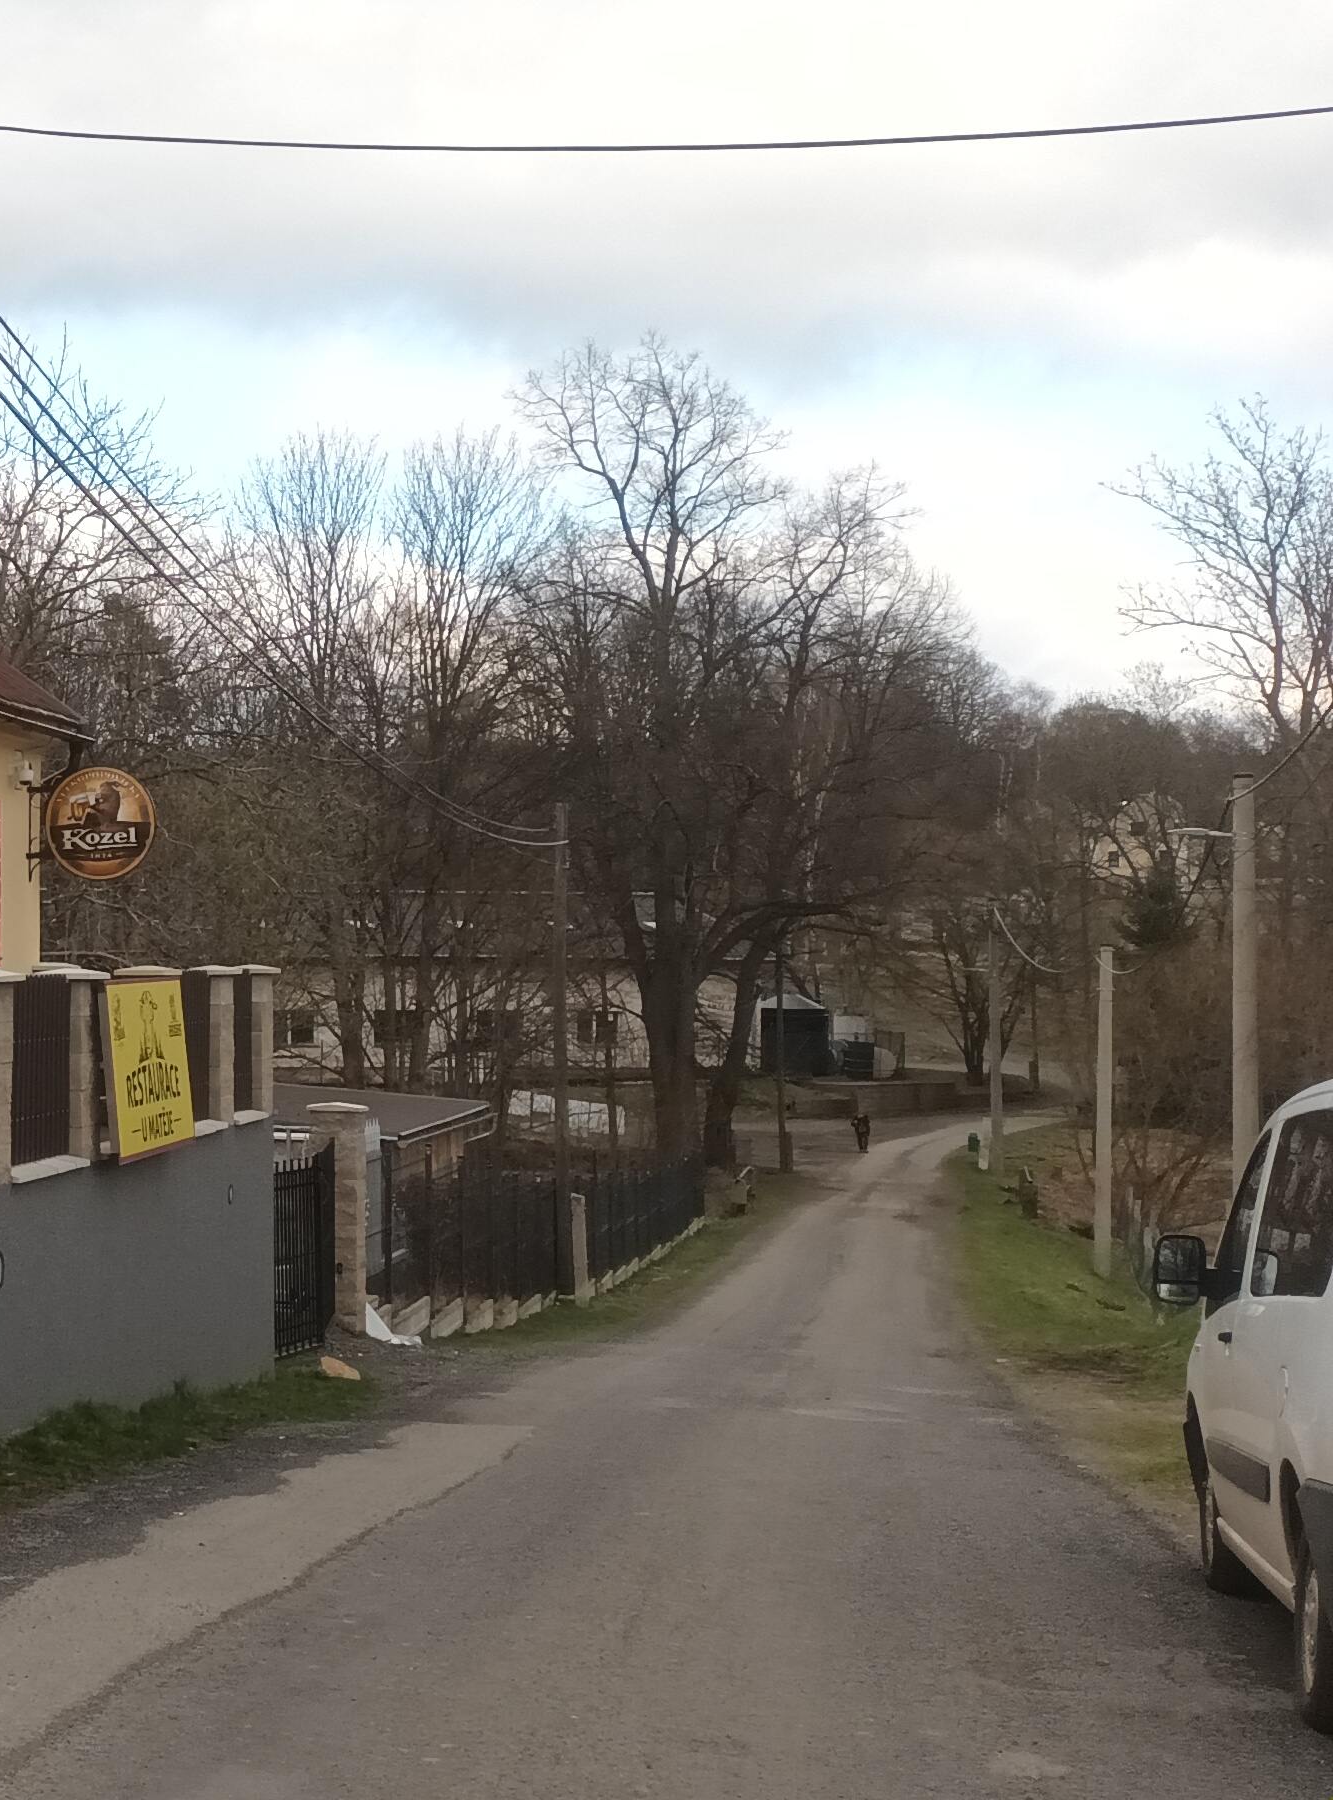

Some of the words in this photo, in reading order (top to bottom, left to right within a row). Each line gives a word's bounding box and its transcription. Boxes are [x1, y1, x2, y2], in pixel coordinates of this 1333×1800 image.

[62, 827, 138, 851] Kozel
[126, 1061, 181, 1109] RESTAURACE
[141, 1116, 148, 1142] U
